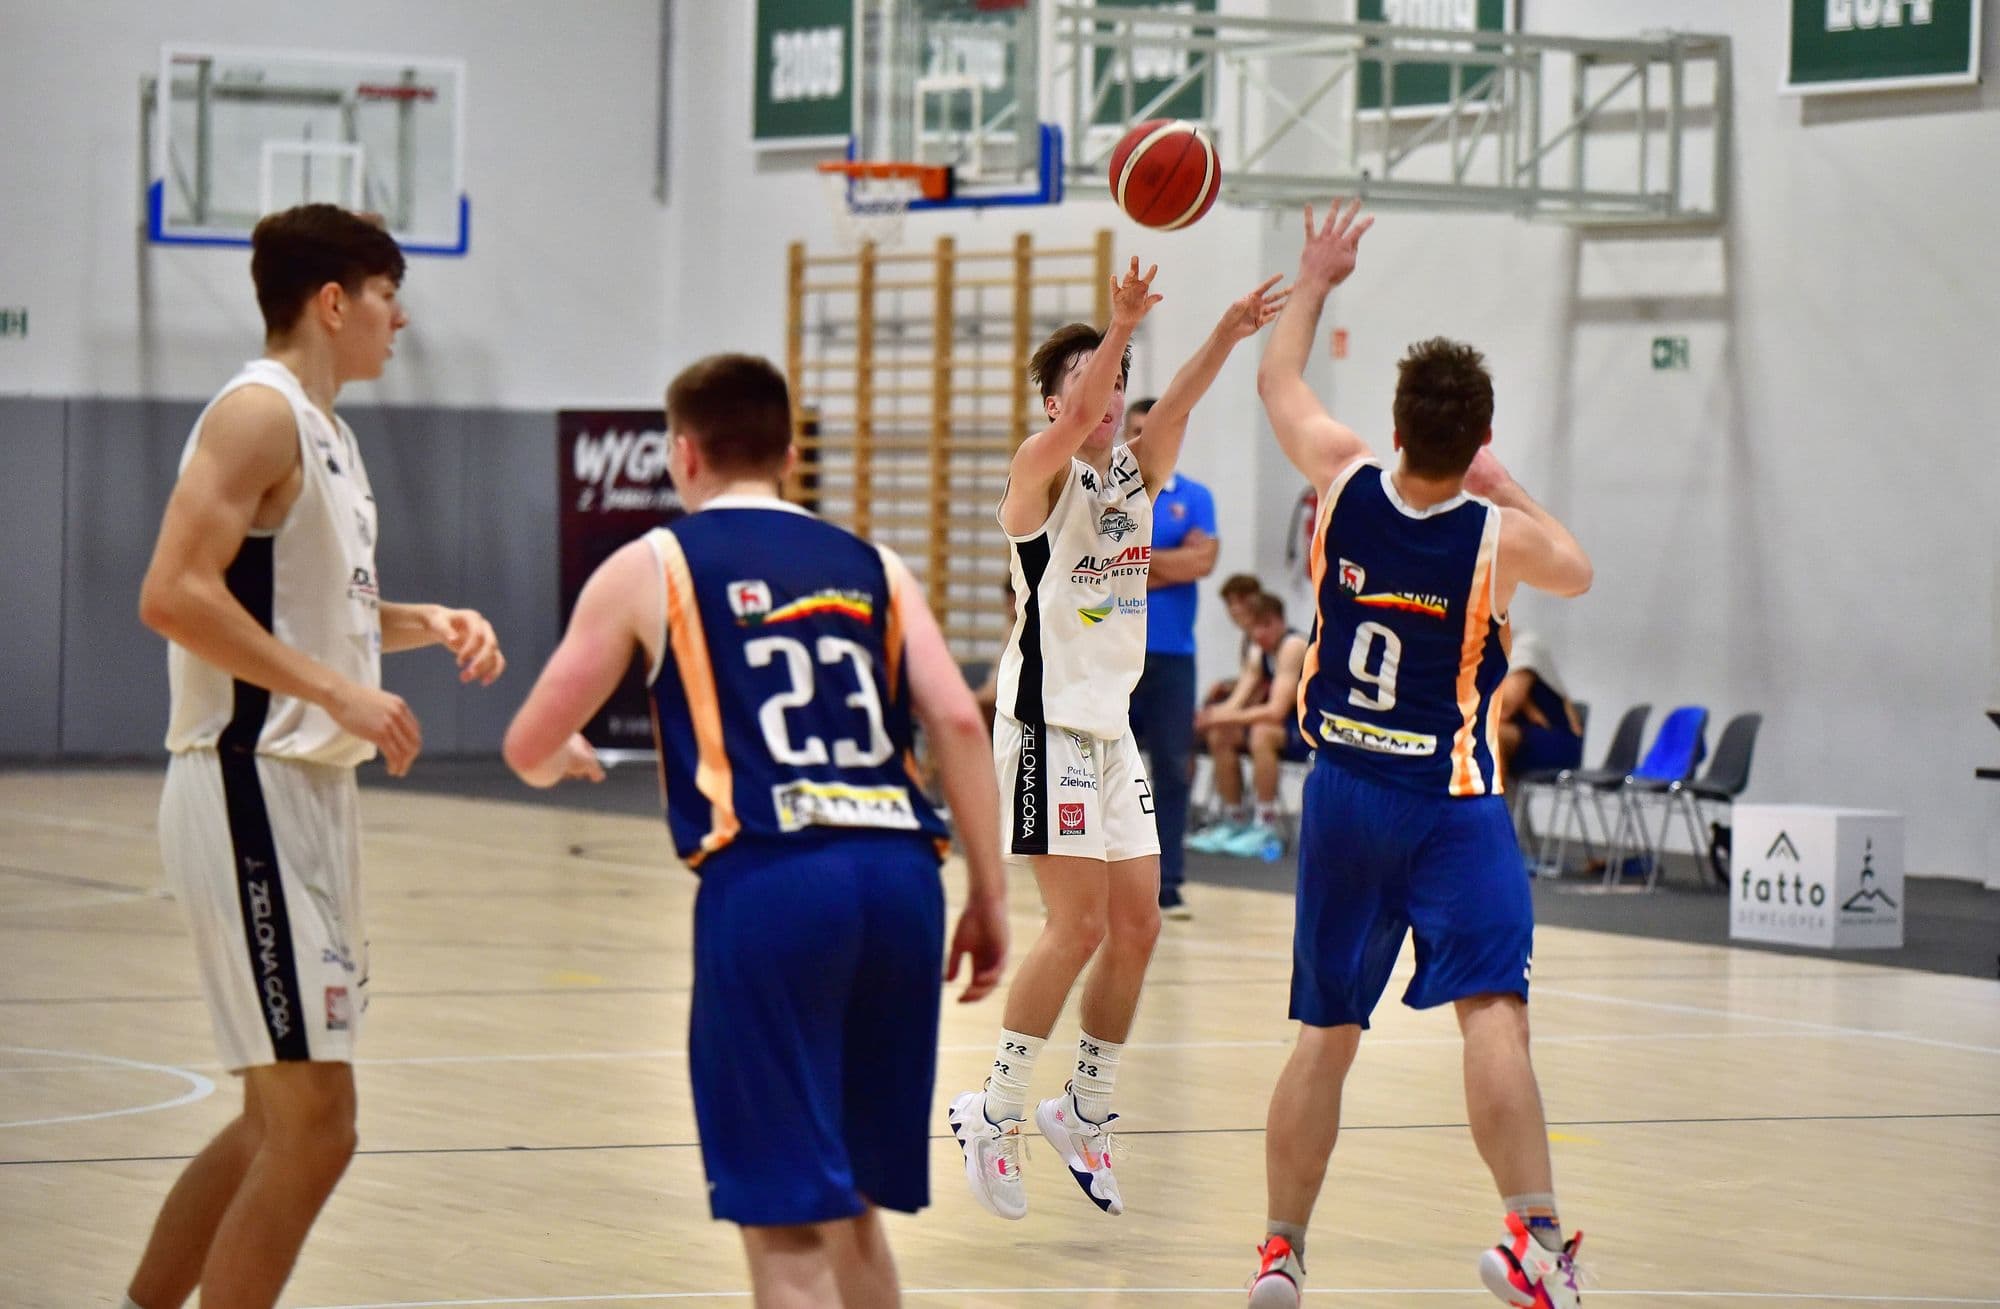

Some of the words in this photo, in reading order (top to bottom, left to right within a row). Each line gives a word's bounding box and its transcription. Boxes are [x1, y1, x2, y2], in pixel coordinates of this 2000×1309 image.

[1348, 621, 1402, 712] 9
[744, 636, 895, 768] 23
[1022, 723, 1036, 792] ZIELONA
[1022, 793, 1037, 839] GÓRA
[1741, 869, 1825, 907] fatto
[1077, 1060, 1098, 1077] 23
